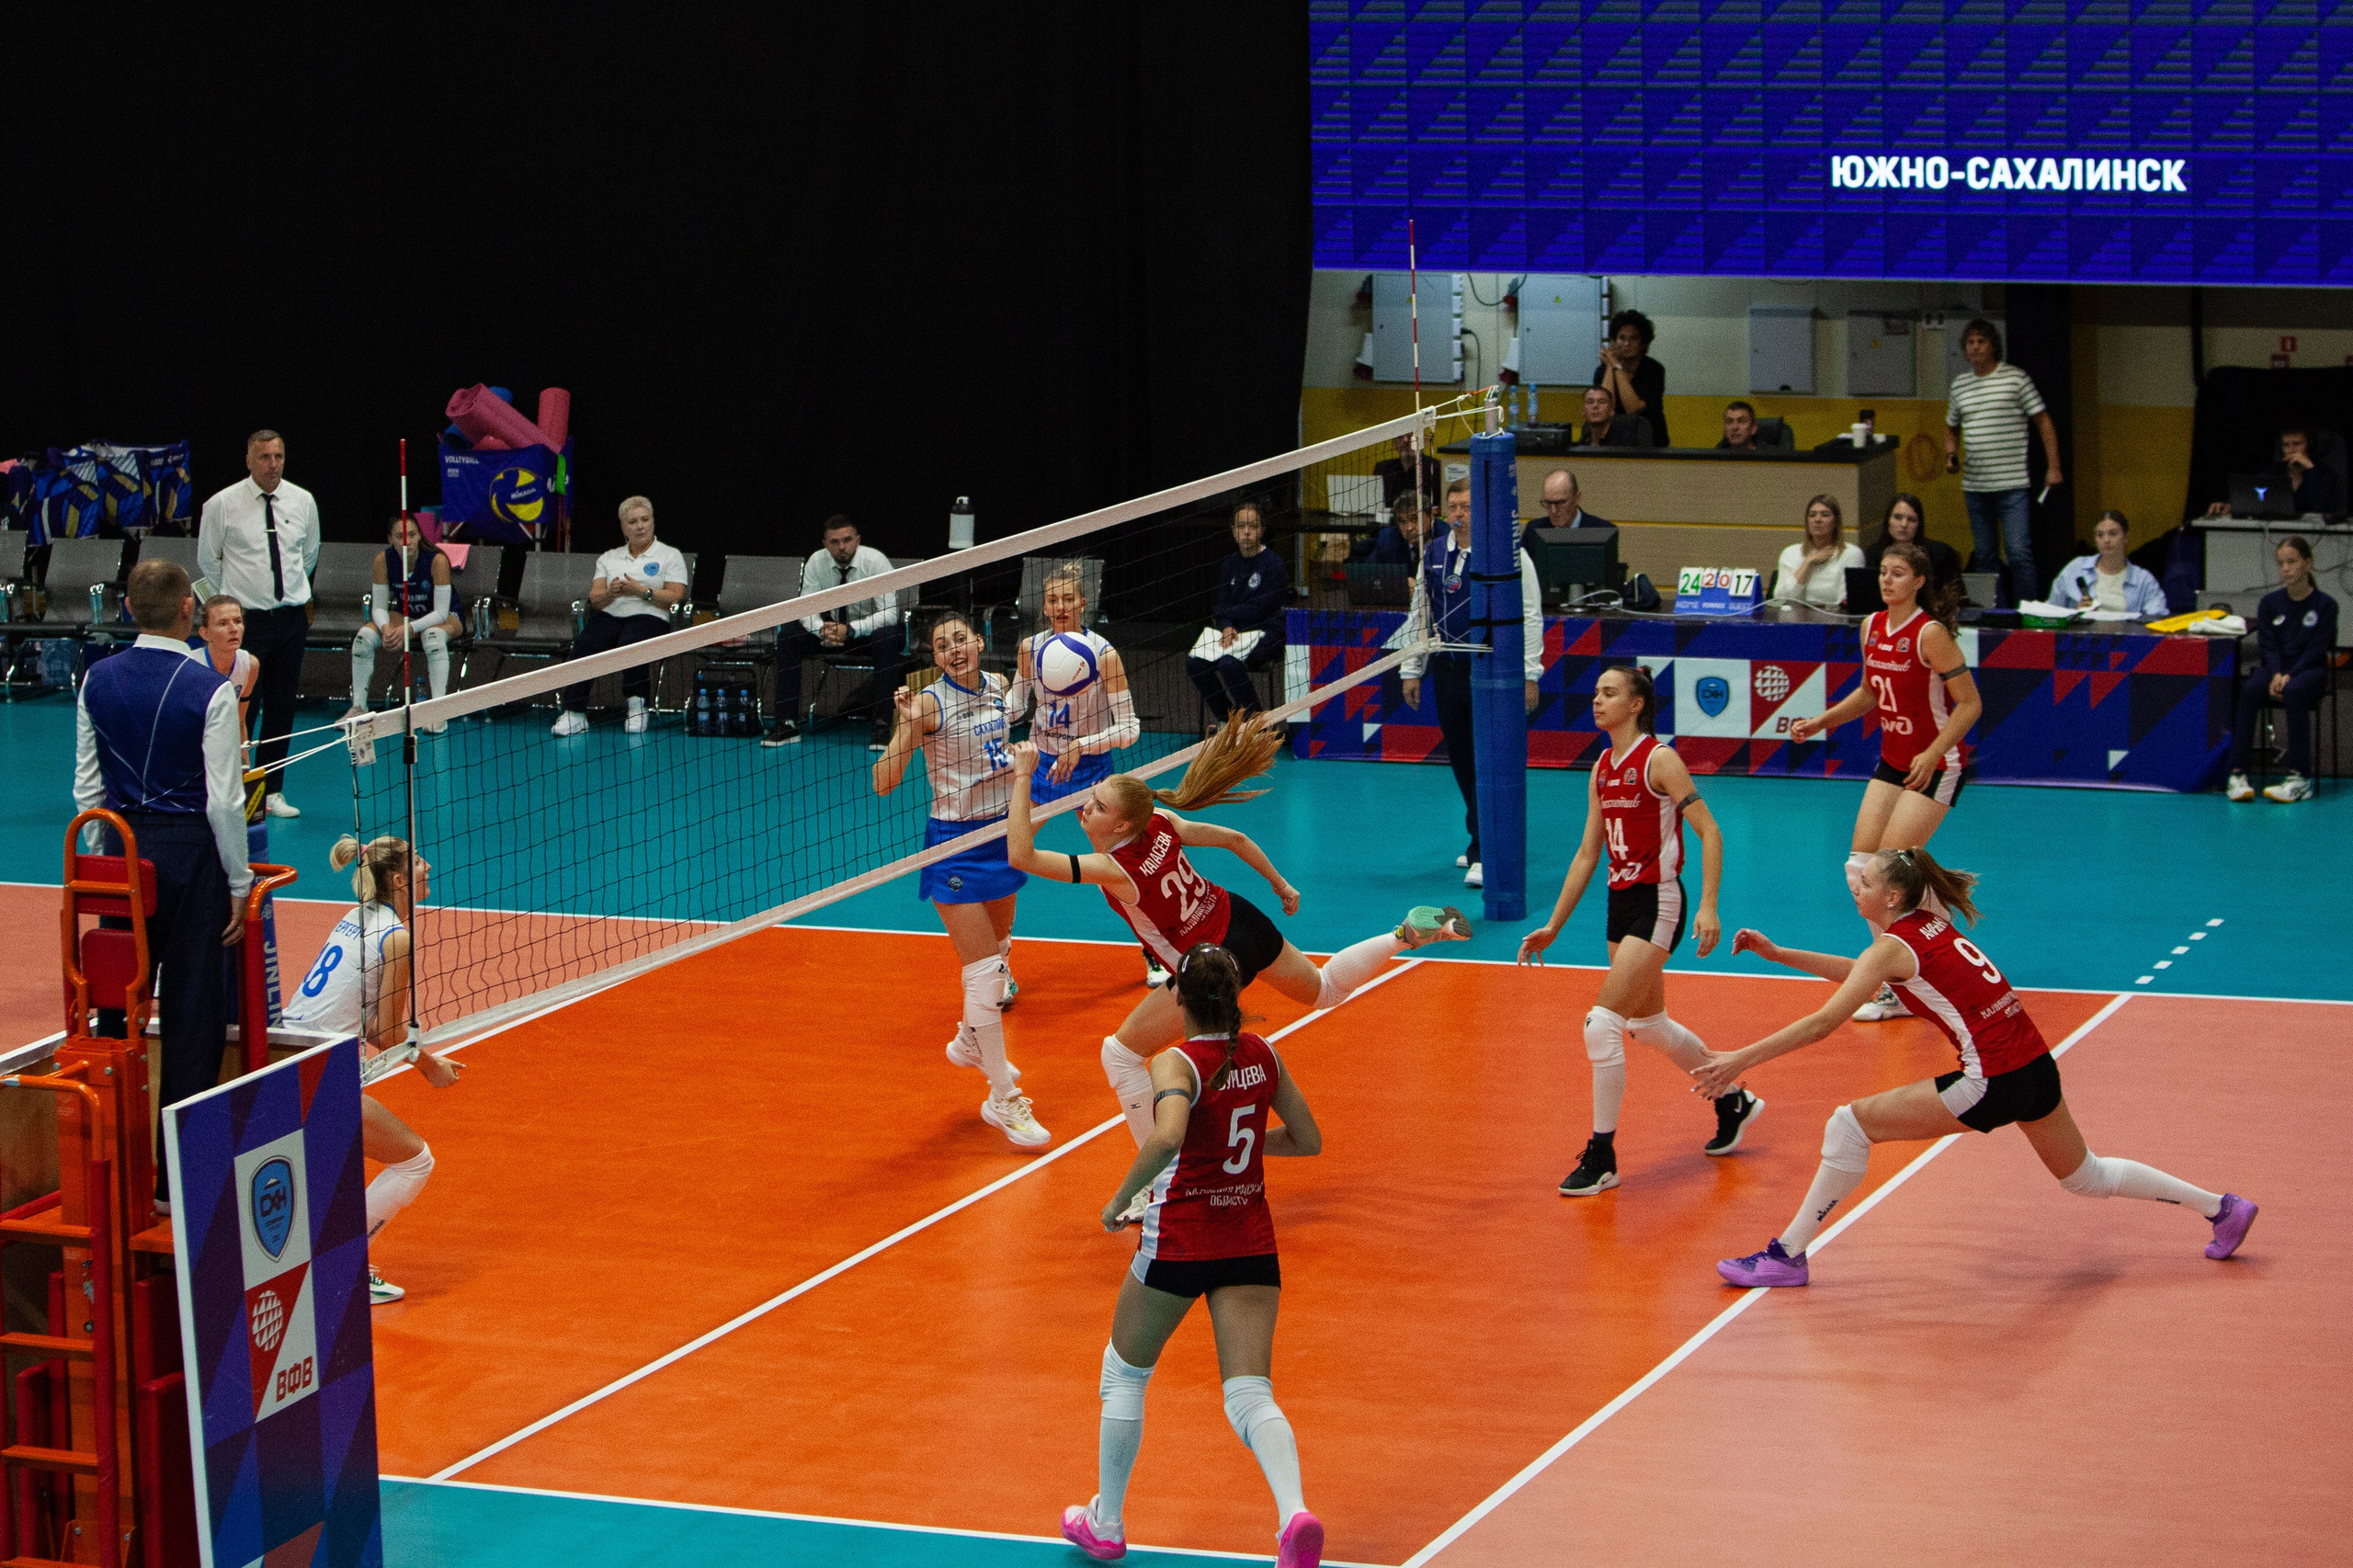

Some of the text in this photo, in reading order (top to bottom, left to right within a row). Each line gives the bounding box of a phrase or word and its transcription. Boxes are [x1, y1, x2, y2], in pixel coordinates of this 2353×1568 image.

[1832, 154, 2188, 191] ЮЖНО-САХАЛИНСК
[445, 455, 480, 464] VOLLEYBALL
[1511, 510, 1521, 572] JINLIN
[1679, 573, 1701, 594] 24
[1735, 574, 1754, 594] 17
[1870, 675, 1897, 712] 21
[1049, 700, 1072, 729] 14
[983, 737, 1009, 771] 15
[1605, 818, 1629, 860] 14
[1161, 848, 1206, 922] 29
[1953, 937, 2001, 983] 9
[1222, 1104, 1256, 1175] 5
[276, 1356, 313, 1403] ВФВ
